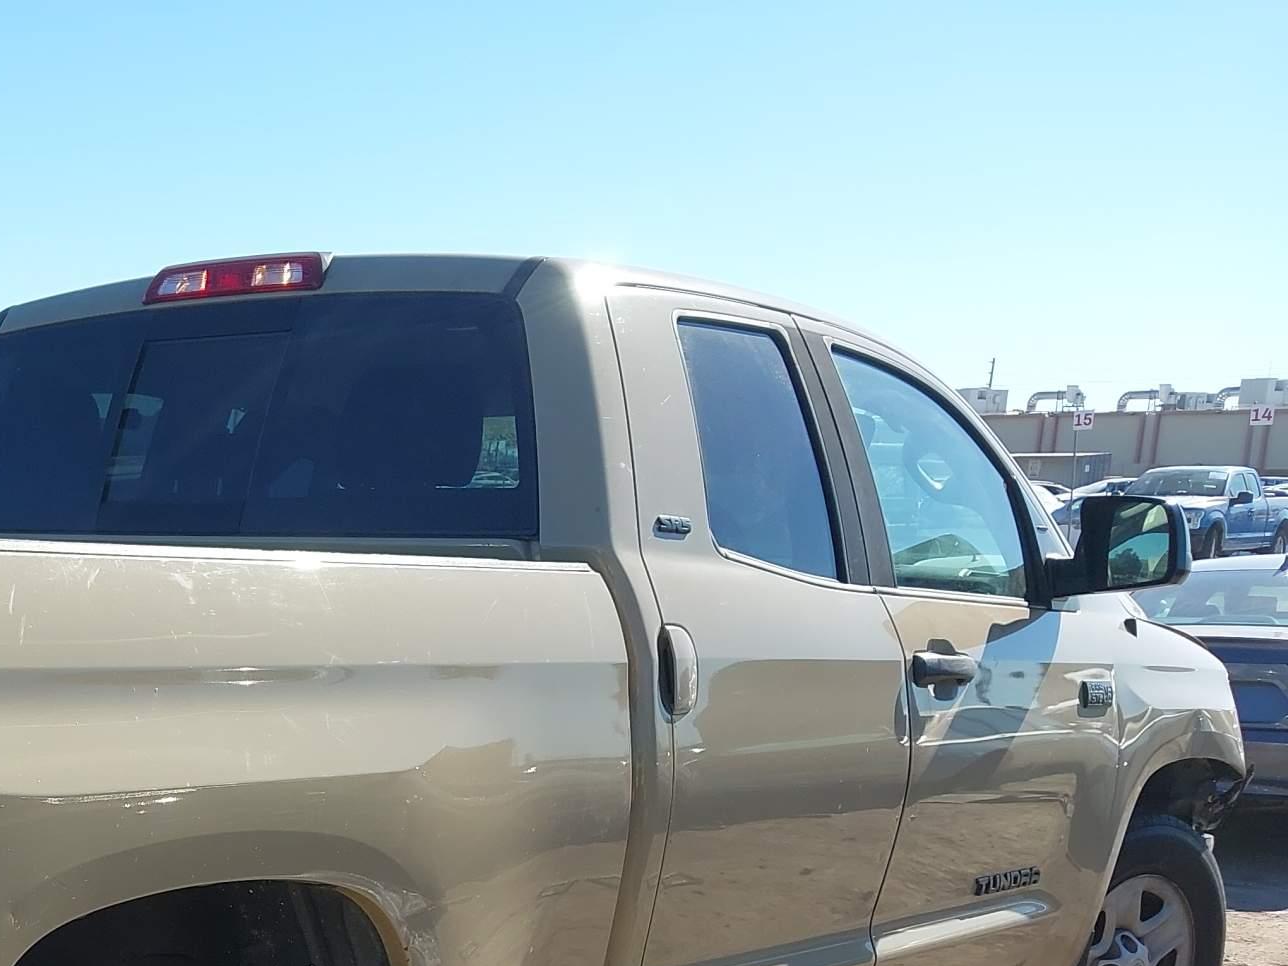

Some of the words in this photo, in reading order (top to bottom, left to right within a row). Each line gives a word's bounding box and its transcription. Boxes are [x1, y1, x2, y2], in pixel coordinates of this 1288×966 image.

[1074, 413, 1092, 426] 15
[1252, 408, 1272, 421] 14
[975, 865, 1040, 896] TUNDRA
